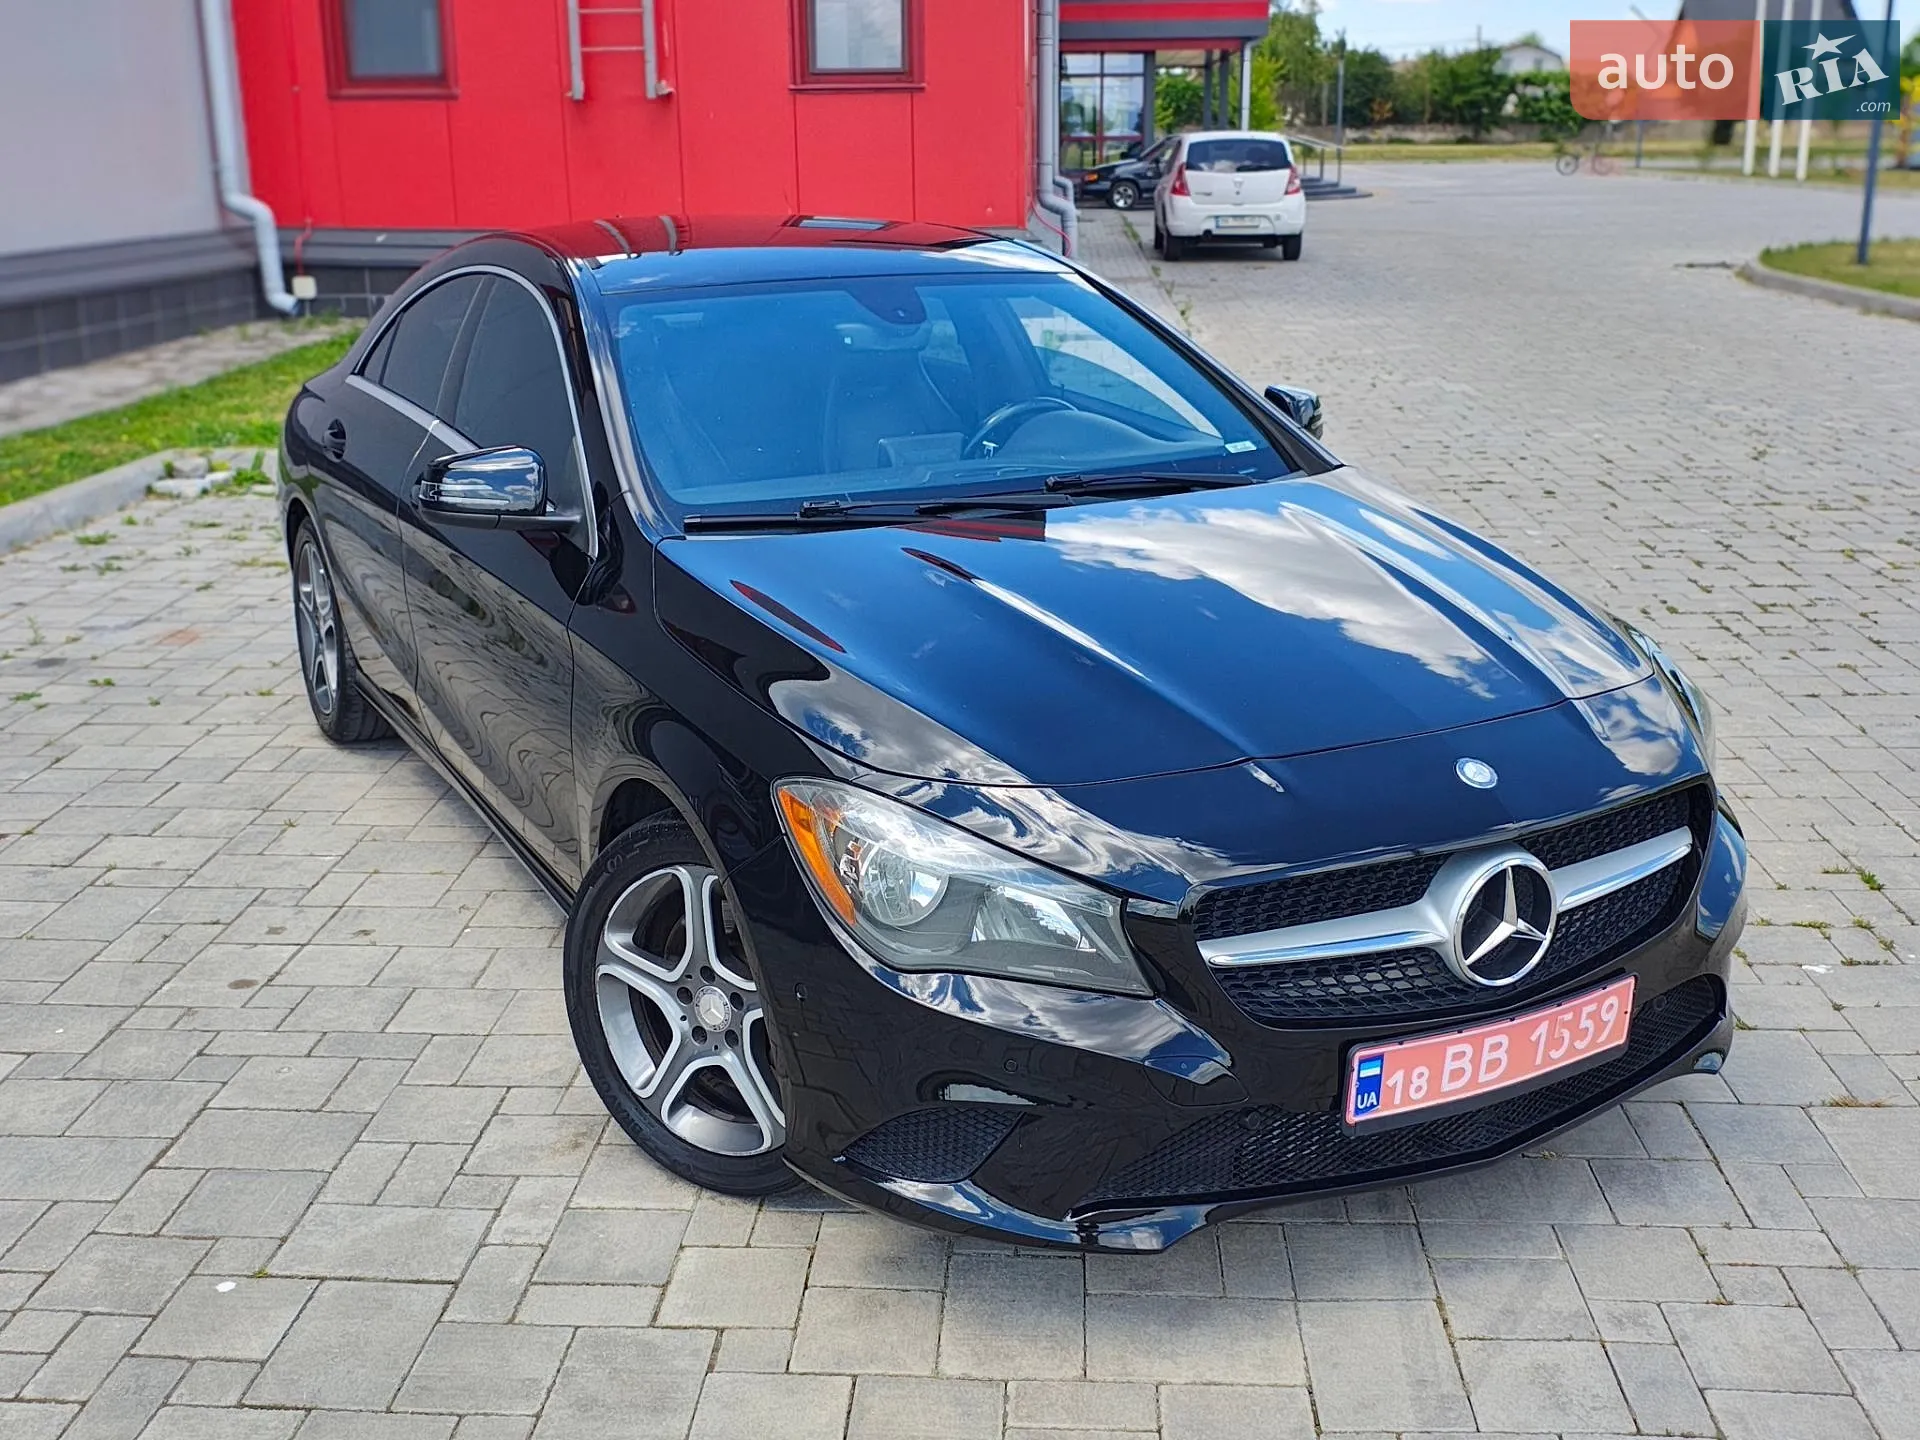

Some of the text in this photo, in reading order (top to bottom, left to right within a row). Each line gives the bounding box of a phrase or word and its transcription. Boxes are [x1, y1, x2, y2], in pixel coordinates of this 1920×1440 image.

[1386, 995, 1620, 1105] 18 BB 1559
[1356, 1092, 1378, 1110] UA
